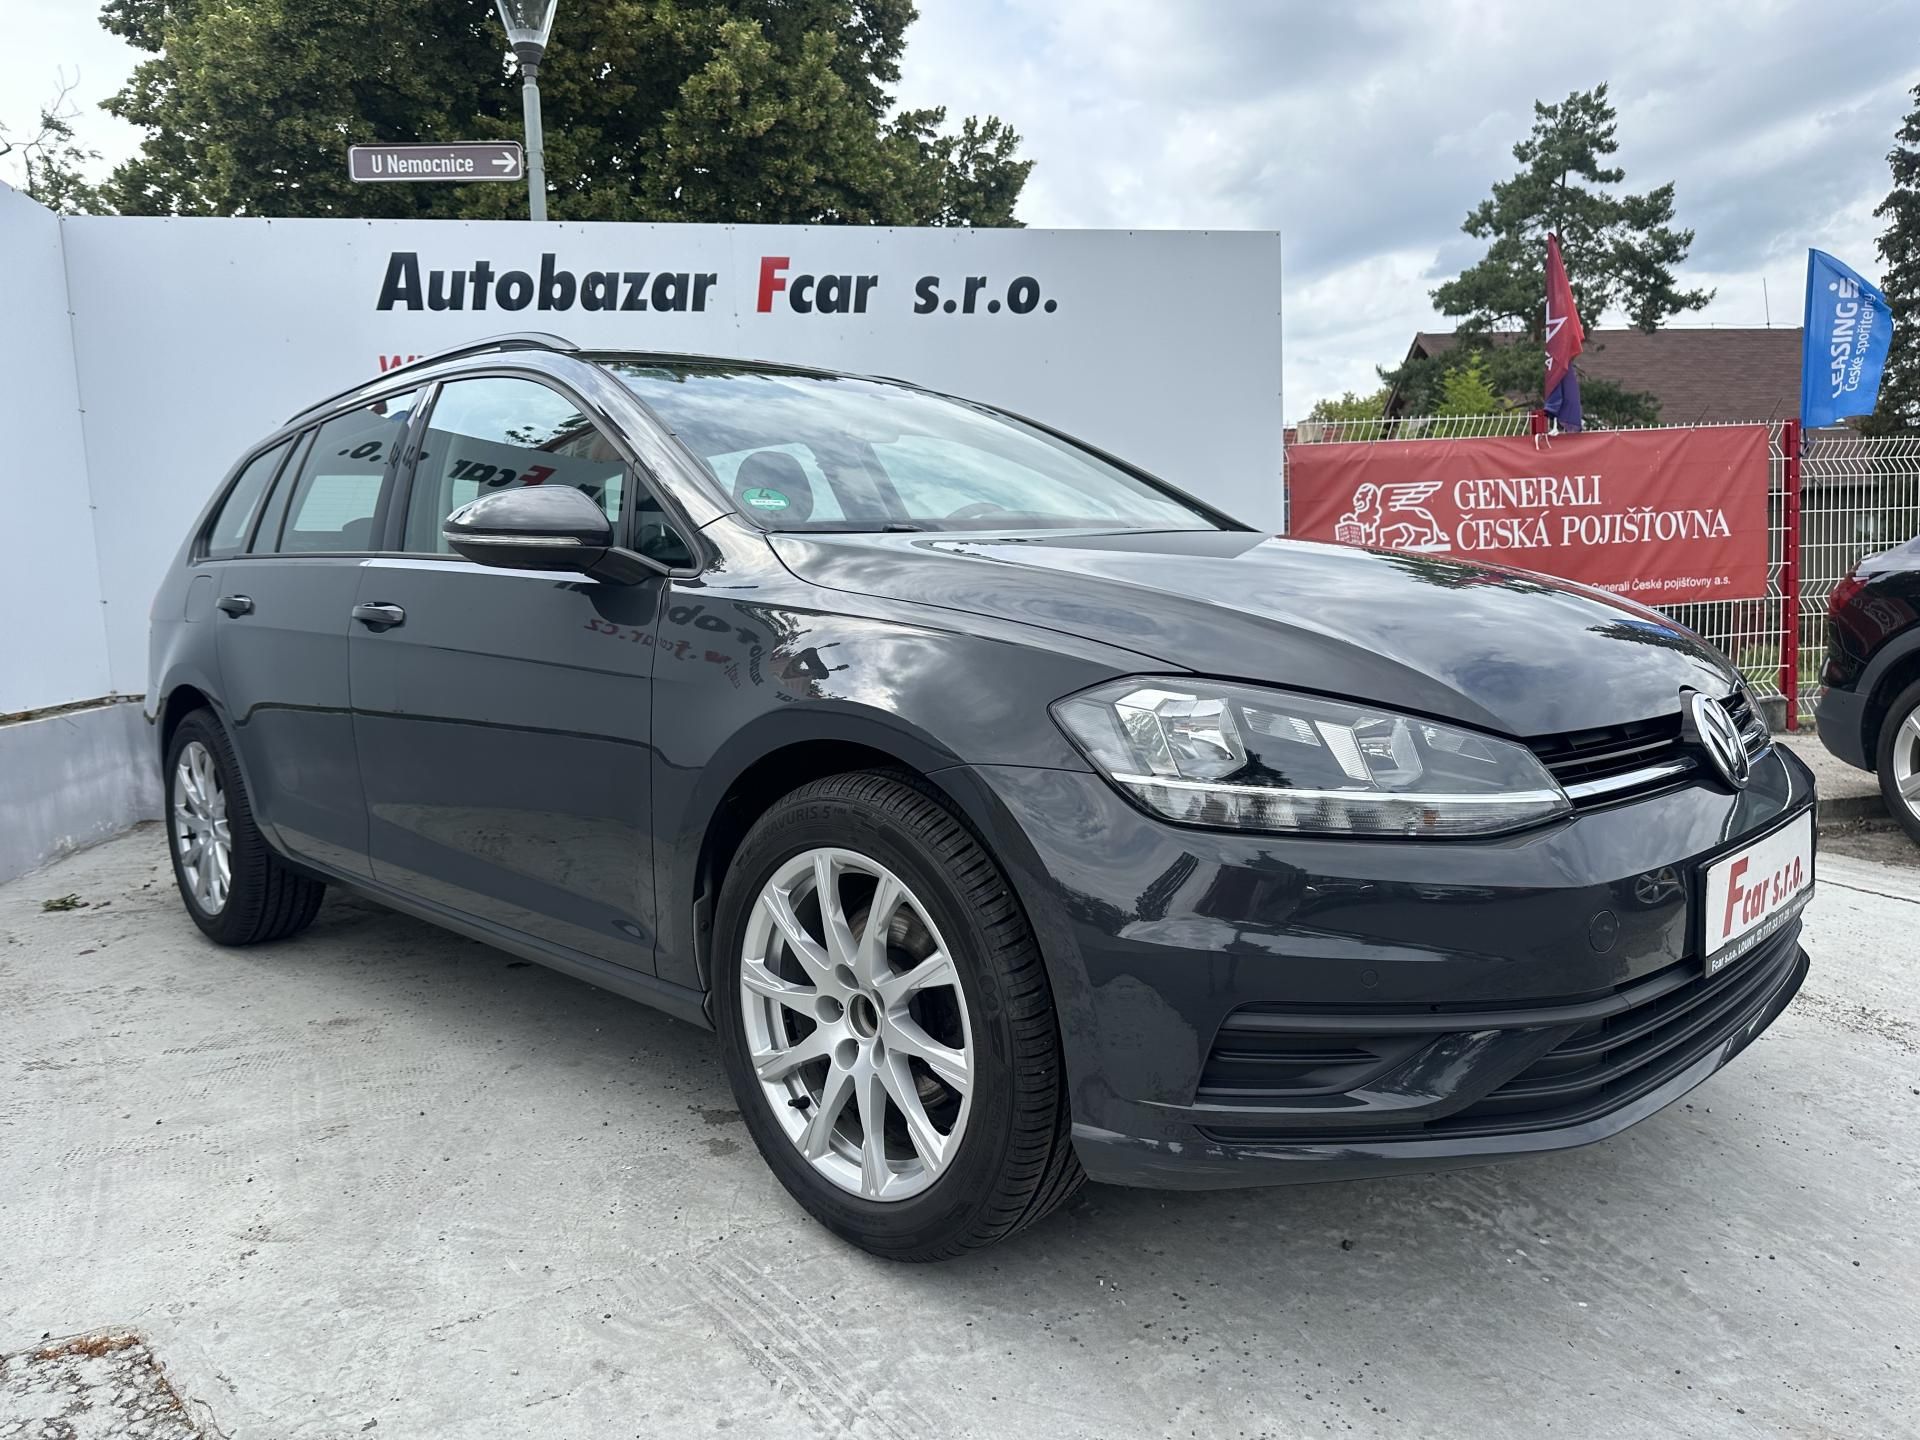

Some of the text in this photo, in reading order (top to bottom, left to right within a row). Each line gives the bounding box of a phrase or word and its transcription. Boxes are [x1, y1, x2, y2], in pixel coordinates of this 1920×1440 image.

[371, 153, 474, 173] U Nemocnice
[376, 251, 1058, 314] Autobazar Fcar s.r.o.
[1453, 474, 1602, 511] GENERALI
[1456, 505, 1731, 551] ČESKÁ POJIŠŤOVNA
[1632, 578, 1662, 591] České
[1714, 575, 1731, 585] a.s.
[1723, 855, 1803, 938] Fcar s.r.o.
